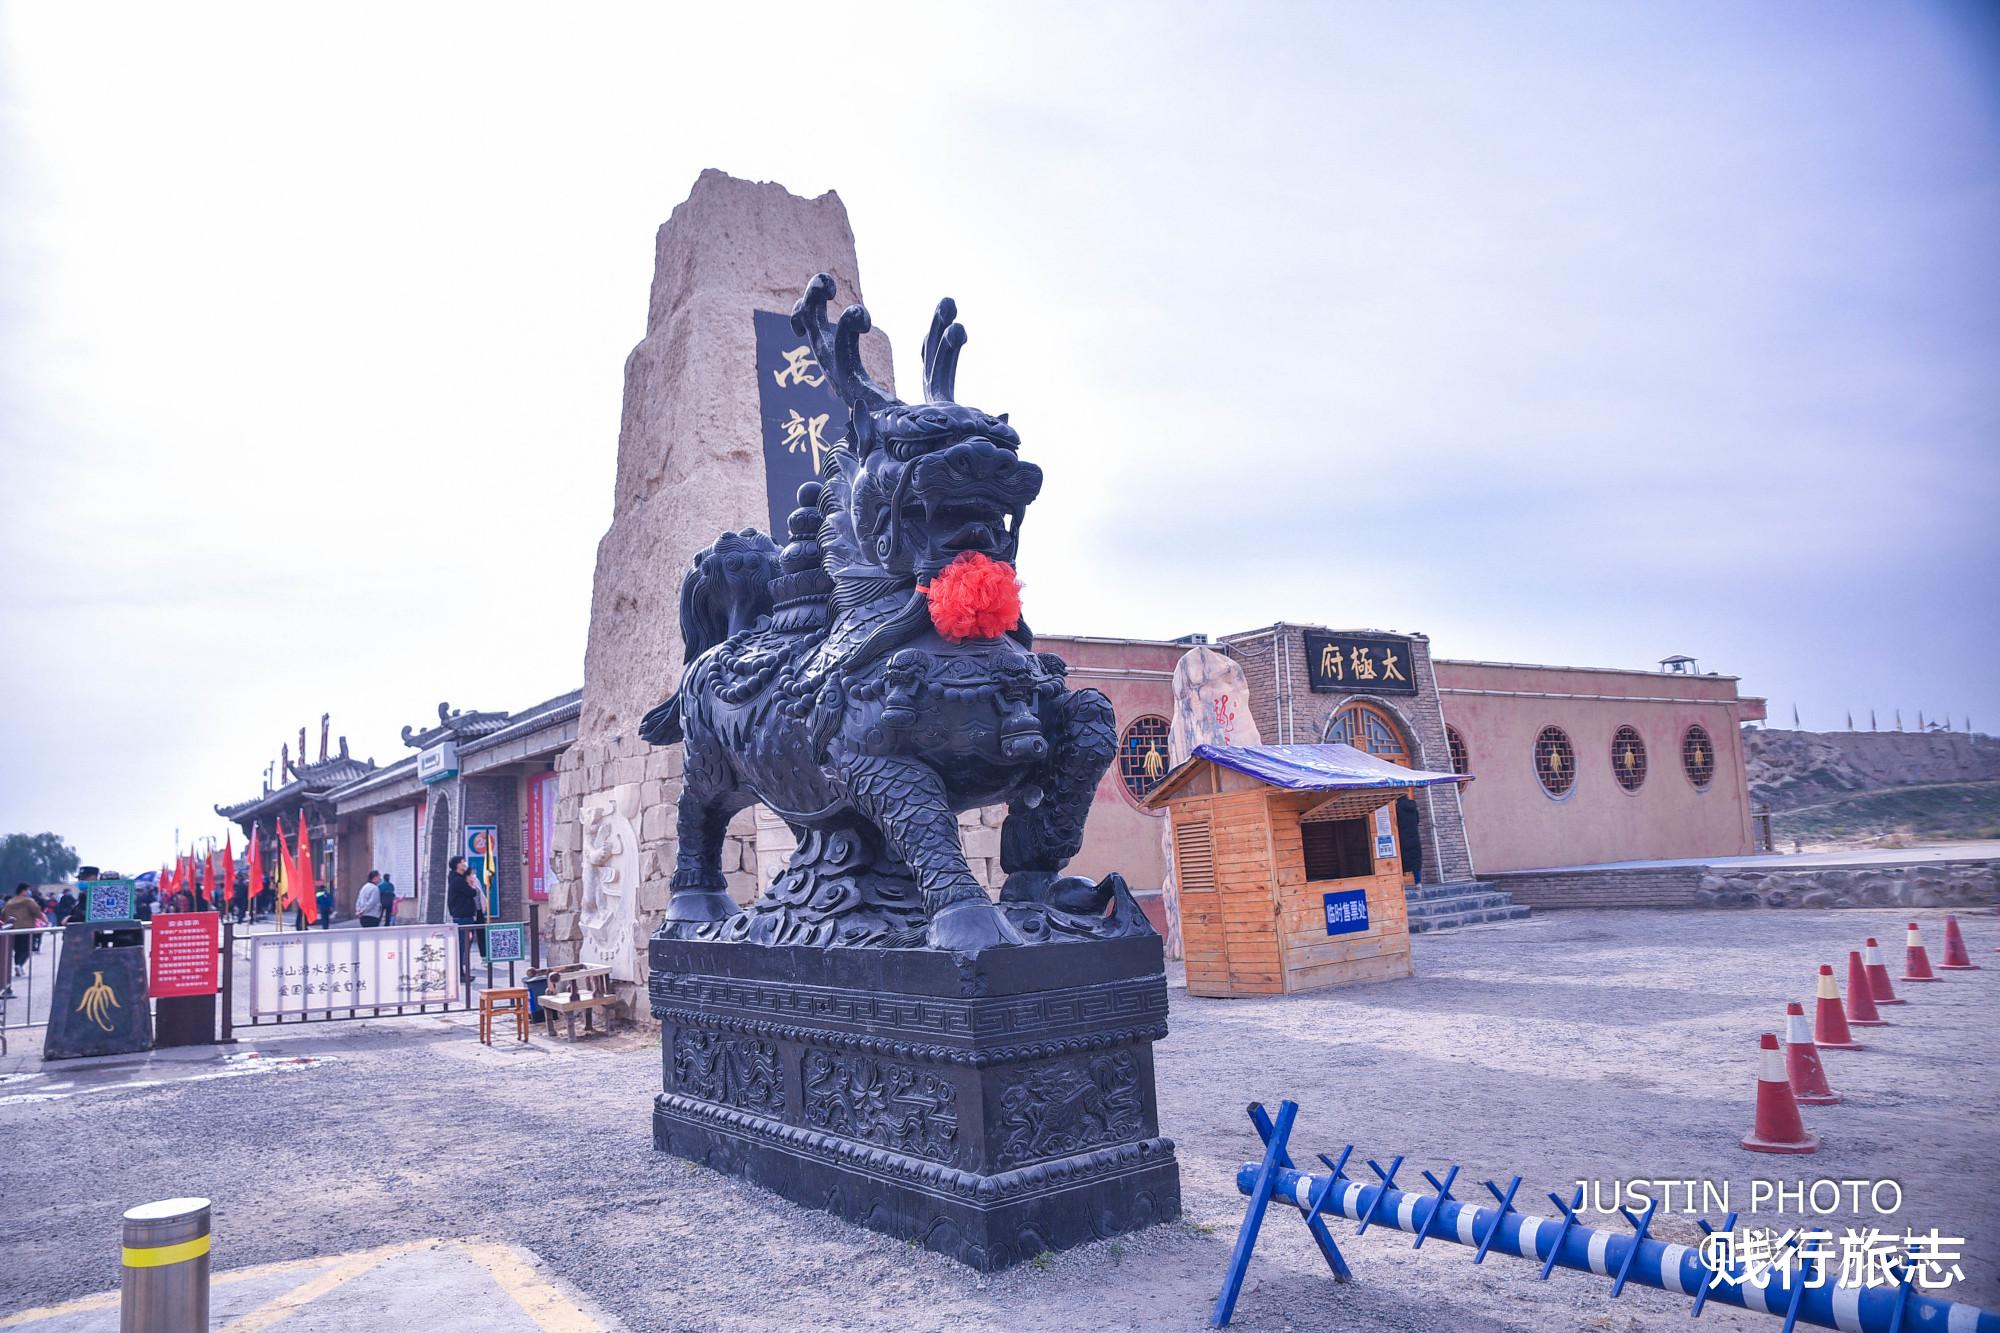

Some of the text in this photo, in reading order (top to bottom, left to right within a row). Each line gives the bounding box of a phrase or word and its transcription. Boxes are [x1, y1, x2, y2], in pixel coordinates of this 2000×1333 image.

[1326, 900, 1367, 924] 临时售票处
